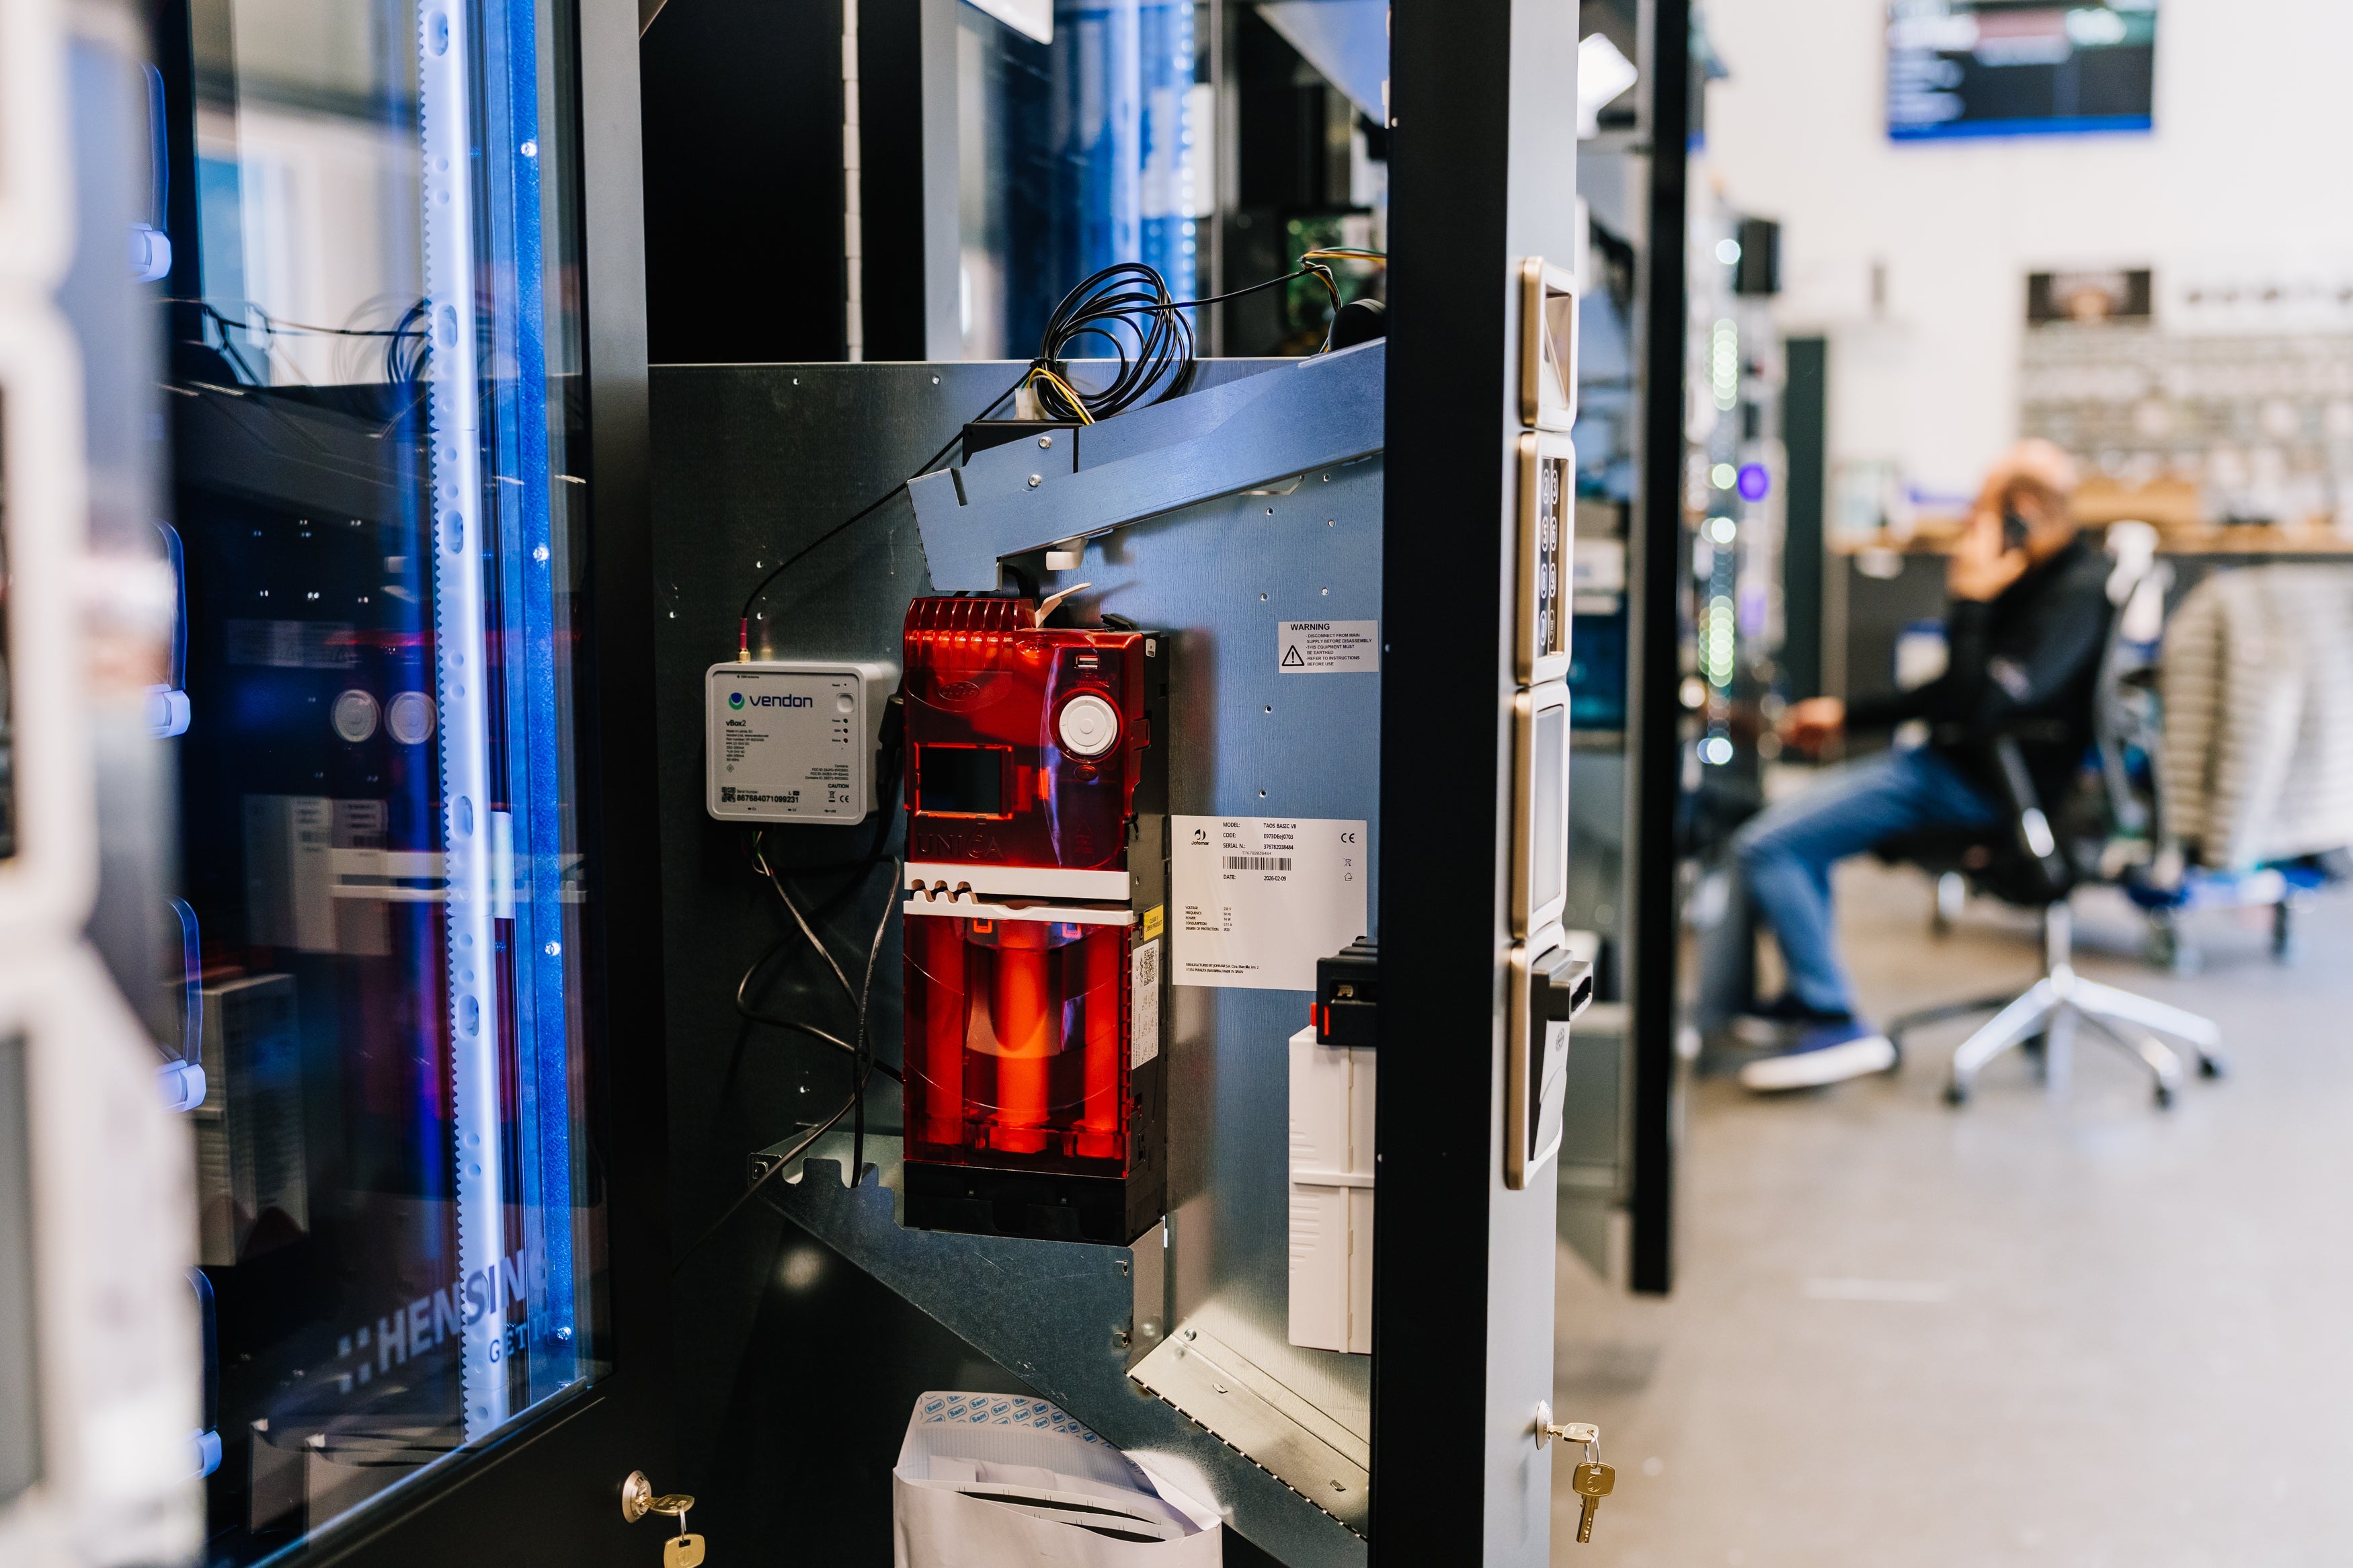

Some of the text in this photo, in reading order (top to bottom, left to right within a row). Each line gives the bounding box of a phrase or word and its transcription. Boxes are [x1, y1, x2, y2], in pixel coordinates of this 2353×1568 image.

[749, 694, 813, 708] vendon
[737, 794, 799, 803] 867684071099231
[489, 1323, 527, 1363] GET
[927, 1402, 942, 1411] Sam
[971, 1398, 986, 1407] Sam
[950, 1407, 964, 1417] Sam
[994, 1405, 1008, 1414] Sam
[1034, 1404, 1047, 1412] Sam
[972, 1413, 986, 1423] Sam
[1015, 1411, 1029, 1420] Sam
[1053, 1413, 1064, 1421] Sam
[1035, 1419, 1048, 1428] Sam
